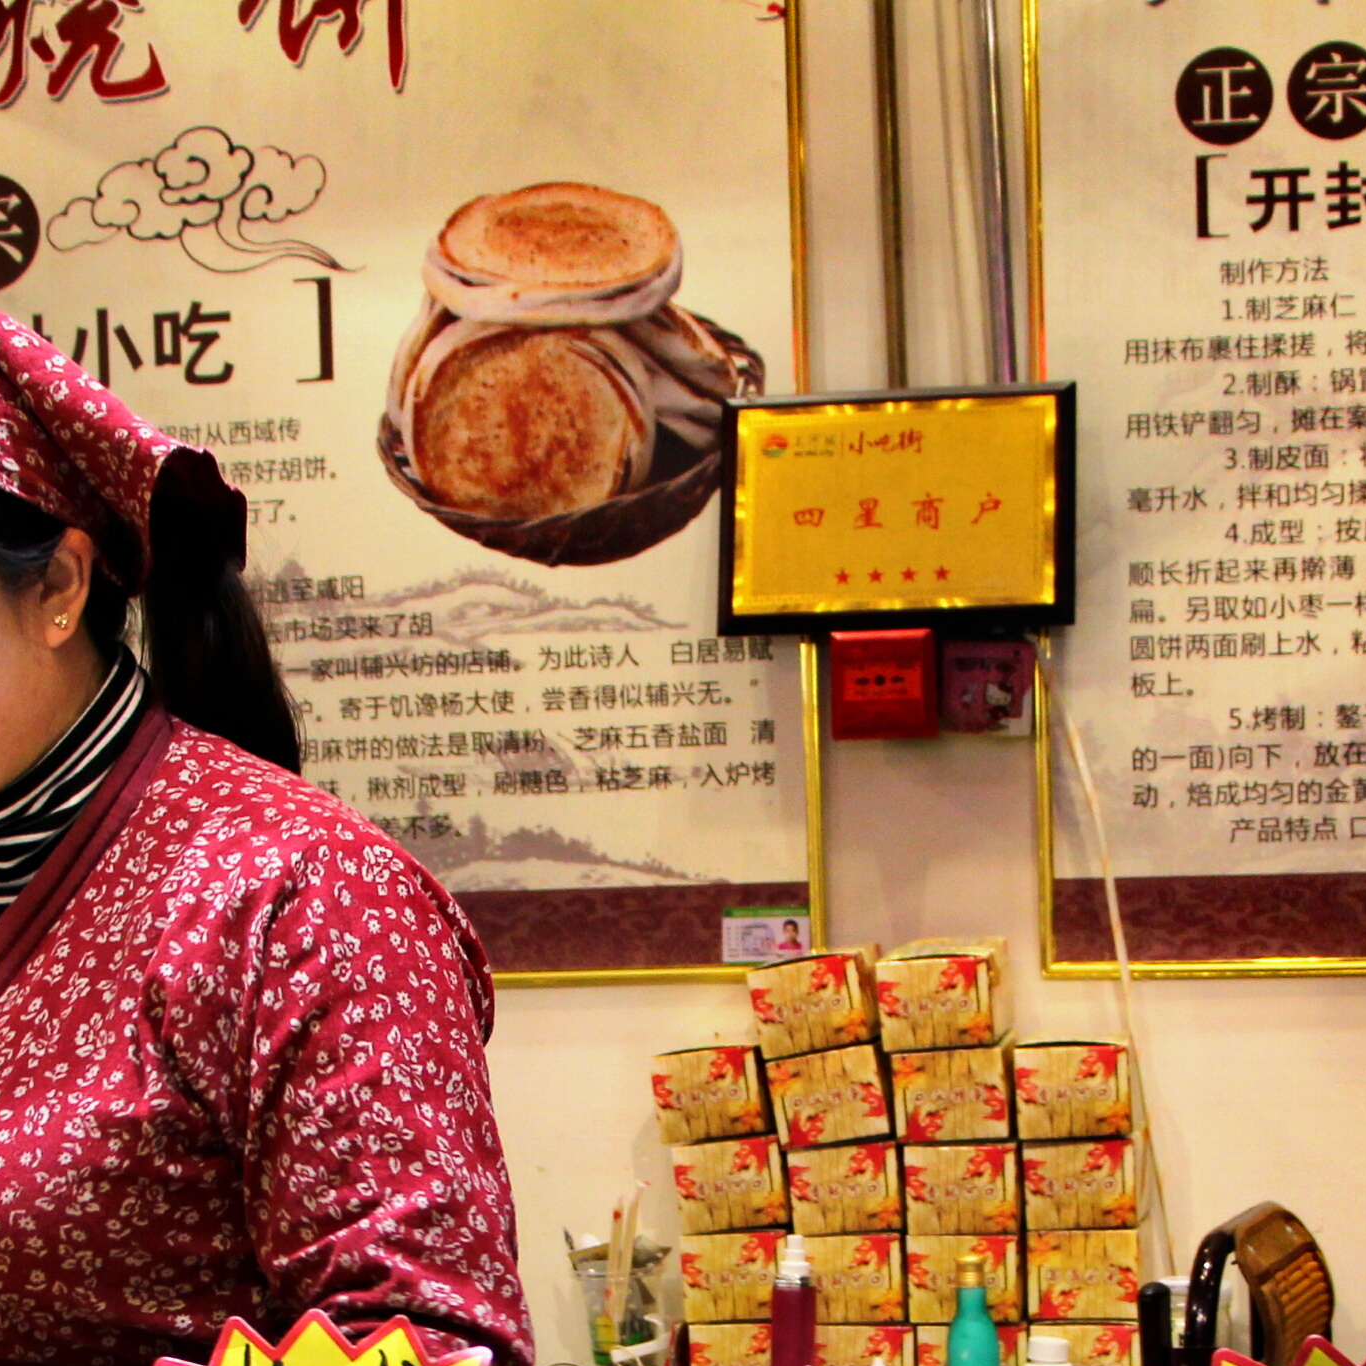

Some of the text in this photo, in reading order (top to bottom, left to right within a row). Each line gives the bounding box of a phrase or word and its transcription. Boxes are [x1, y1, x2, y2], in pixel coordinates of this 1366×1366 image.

[1220, 256, 1329, 286] 制作方法
[793, 491, 1003, 530] 四星商户
[1131, 671, 1195, 698] 板上。
[1229, 817, 1337, 844] 产品特点
